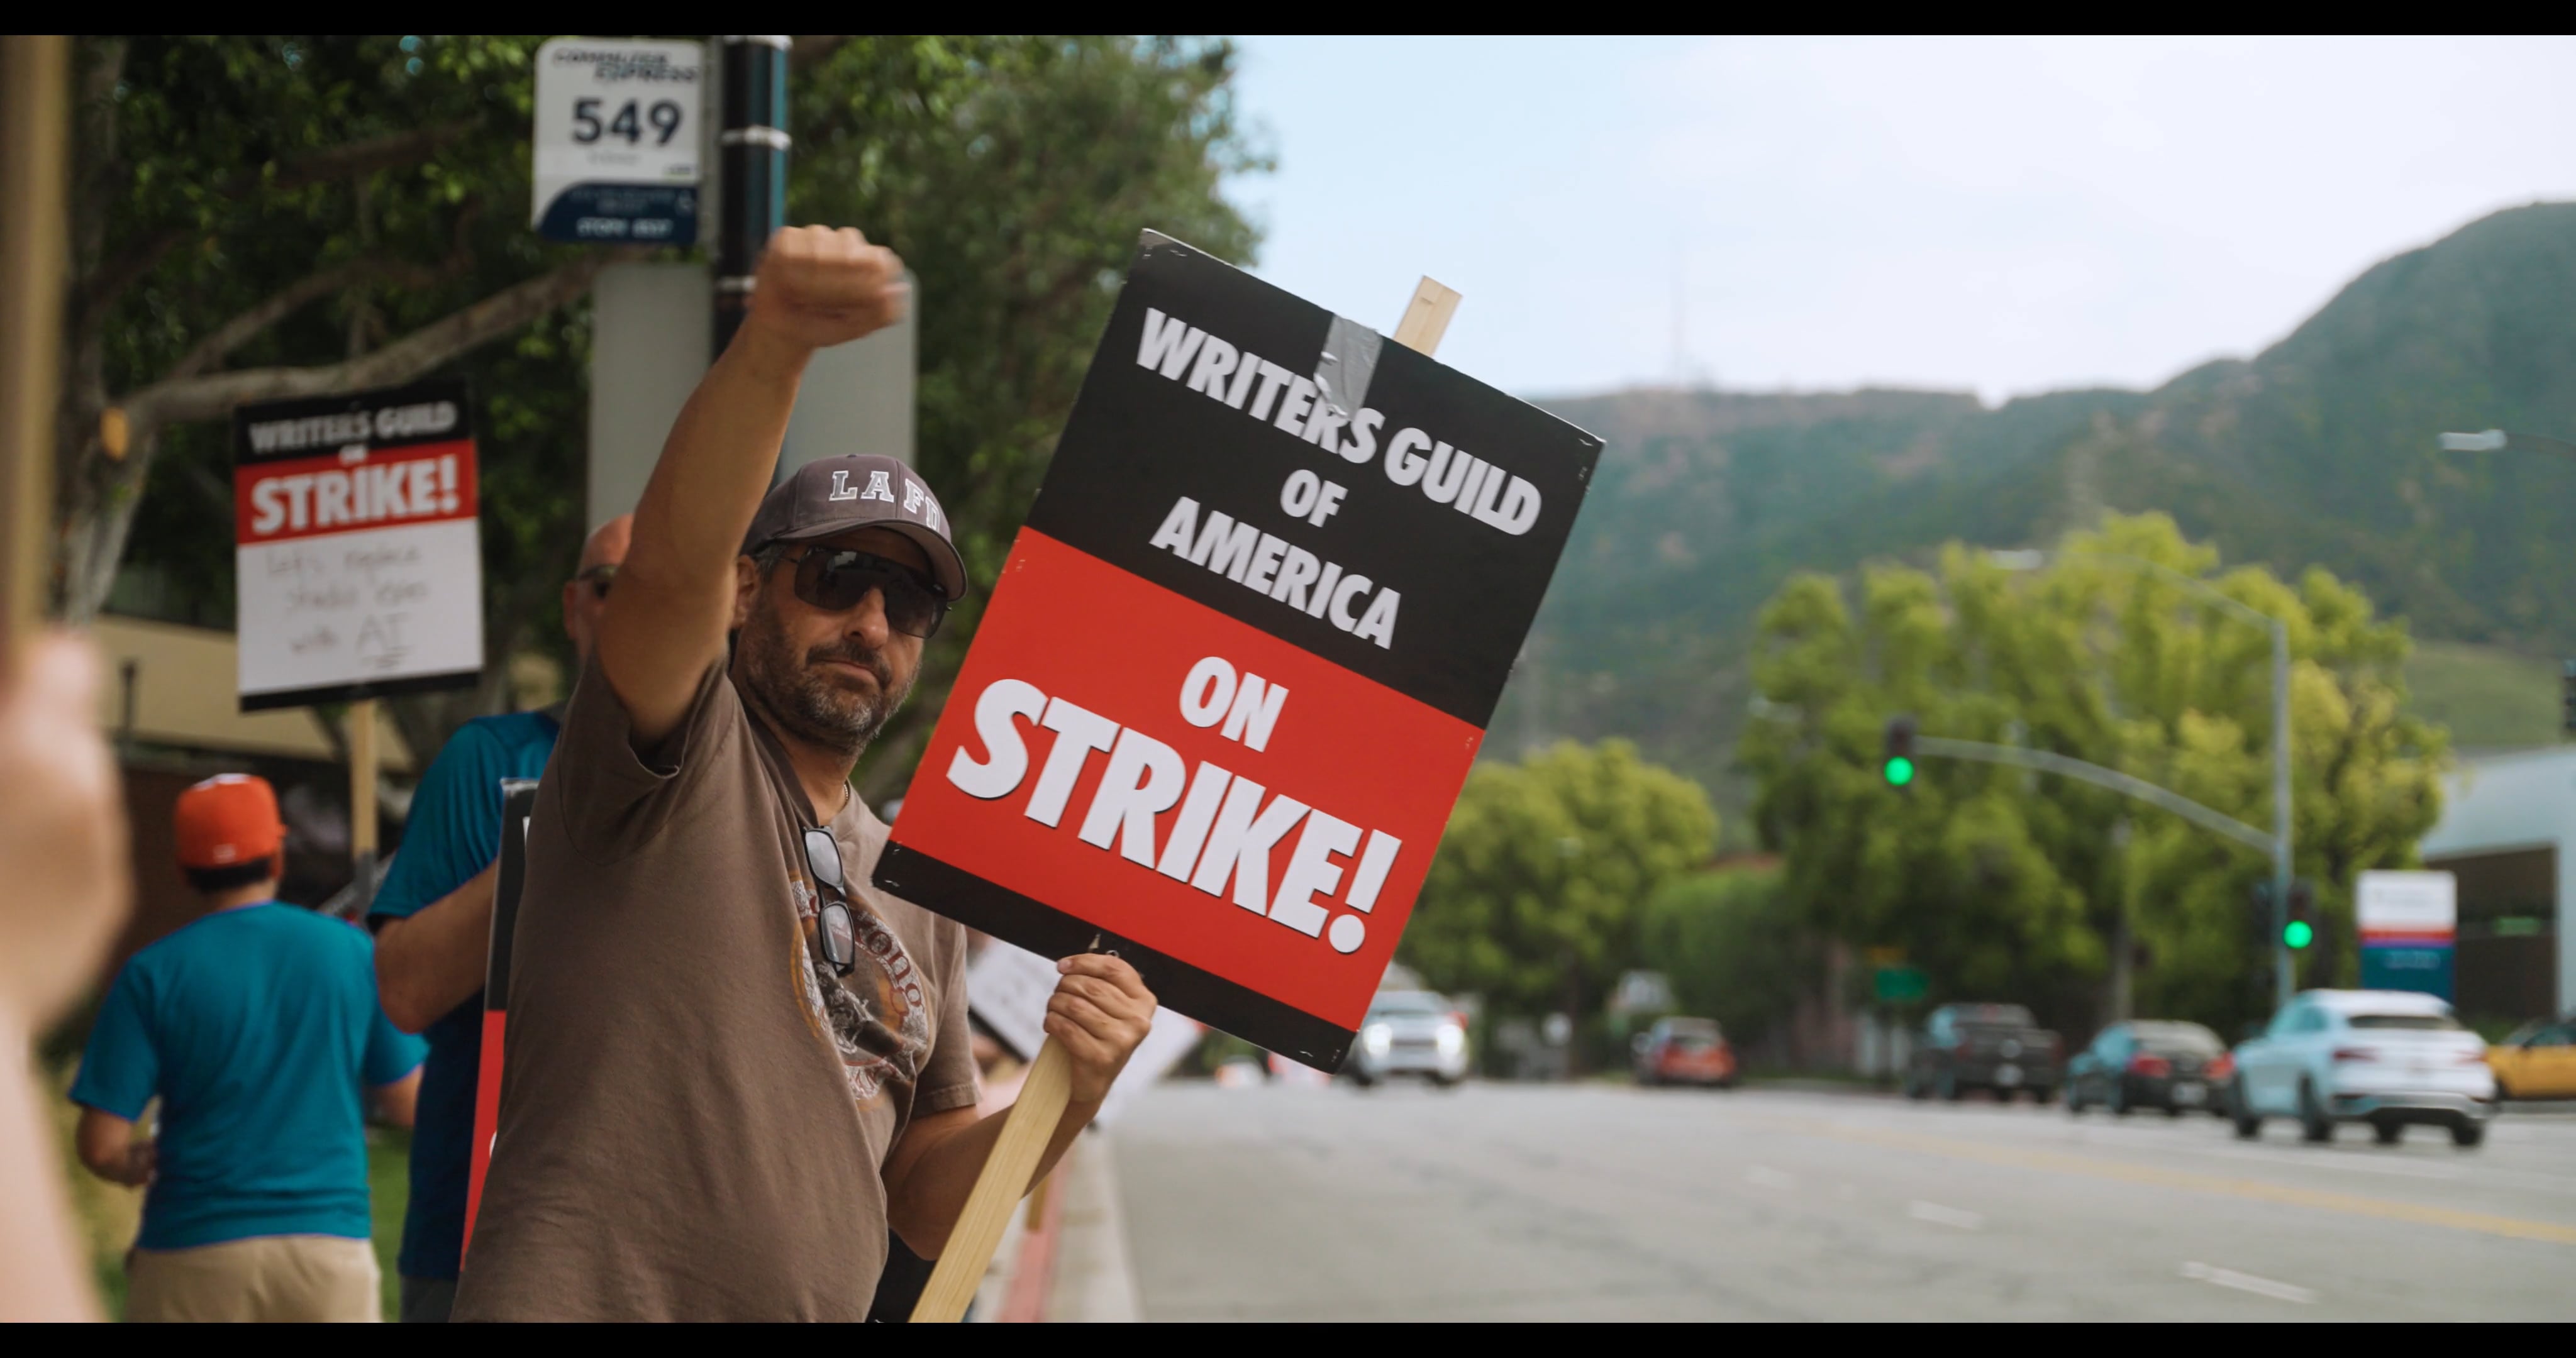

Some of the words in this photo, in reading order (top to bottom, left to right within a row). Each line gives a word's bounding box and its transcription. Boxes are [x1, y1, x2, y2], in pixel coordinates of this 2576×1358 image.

[573, 98, 684, 148] 549
[376, 400, 458, 439] GUILD
[1136, 307, 1386, 464] WRITERS
[1385, 427, 1541, 536] GUILD
[251, 453, 460, 536] STRIKE!
[828, 470, 941, 533] LAFD
[1280, 468, 1348, 528] OF
[1149, 496, 1401, 650] AMERICA
[355, 610, 418, 655] AI
[1179, 656, 1289, 753] ON
[946, 678, 1403, 954] STRIKE!
